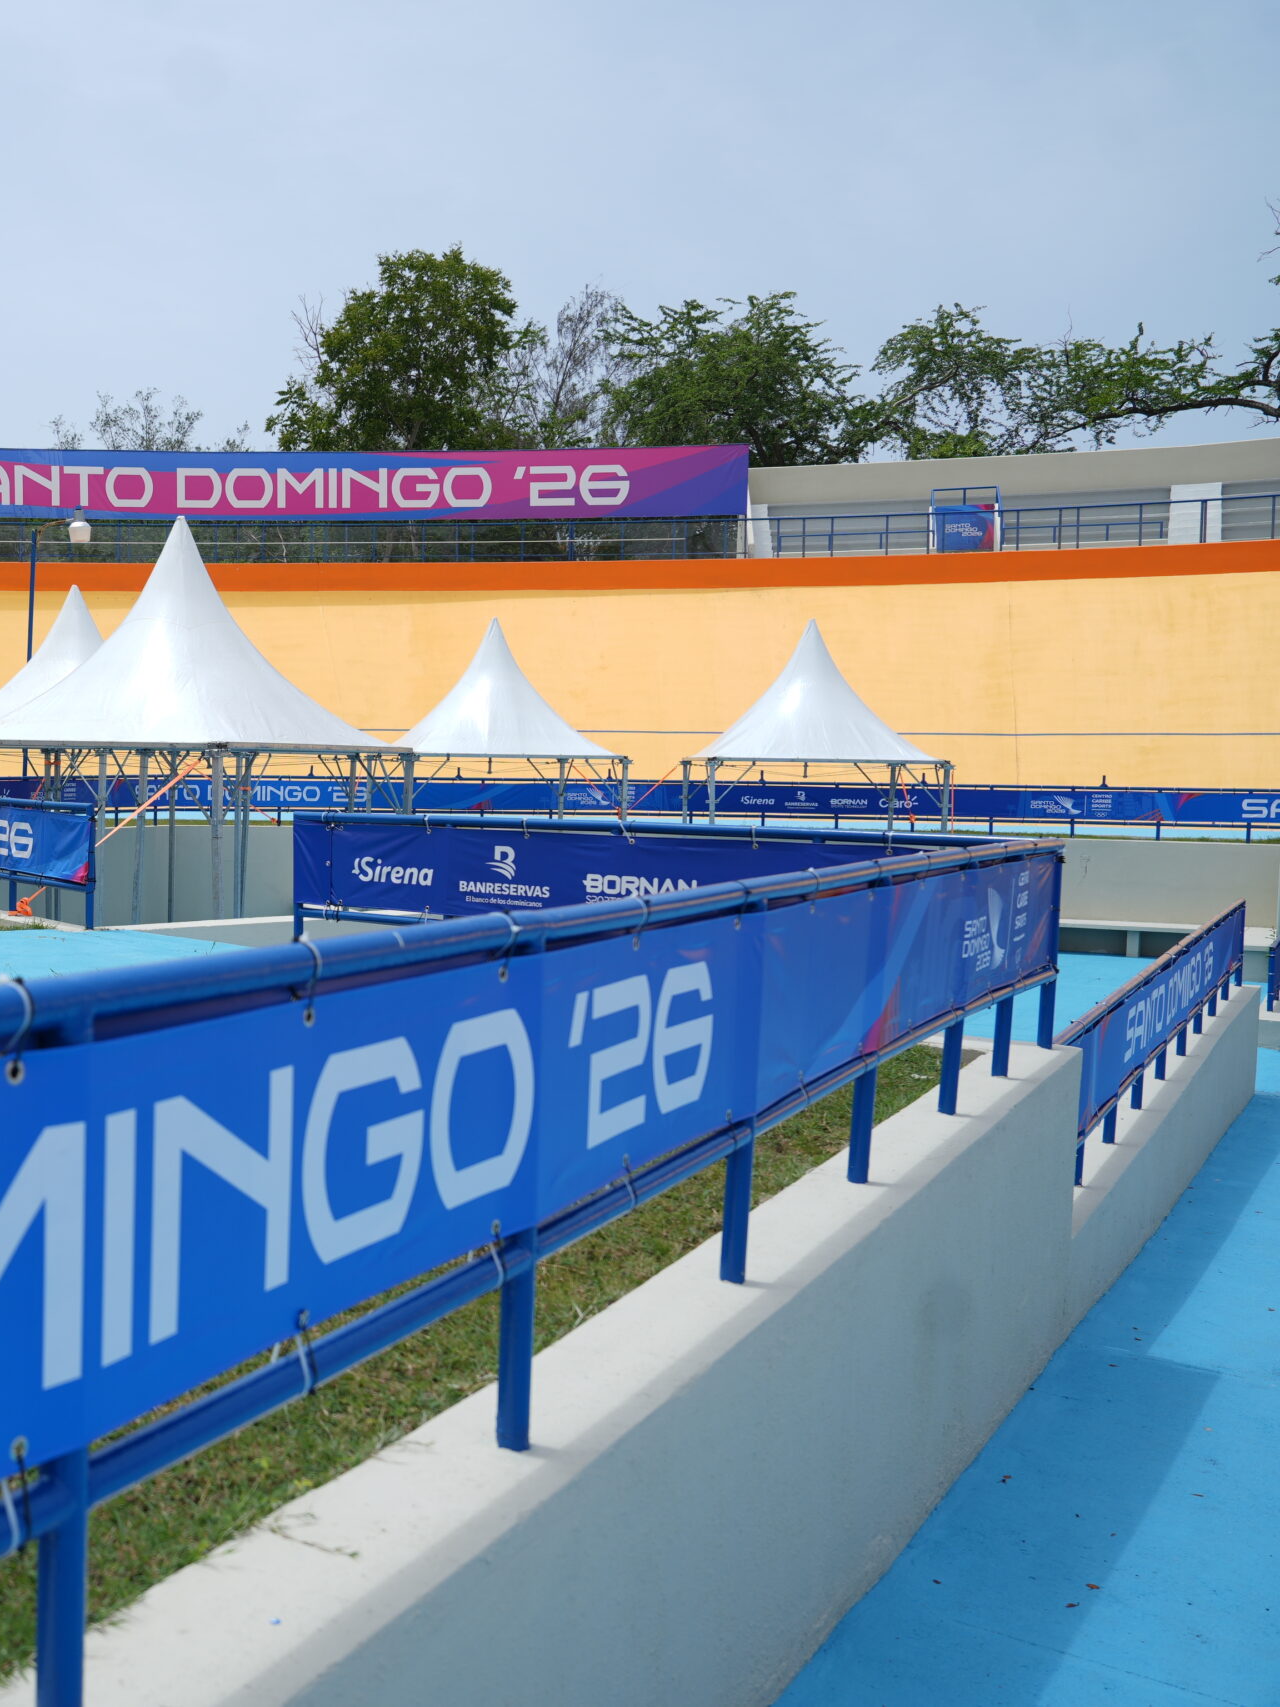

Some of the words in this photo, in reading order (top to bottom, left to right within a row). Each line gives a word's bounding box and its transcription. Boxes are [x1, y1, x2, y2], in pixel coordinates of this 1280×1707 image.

[176, 466, 492, 509] DOMINGO
[513, 464, 630, 507] '26
[741, 795, 775, 805] Sirena
[878, 798, 913, 809] Caro
[358, 856, 434, 886] Sirena
[459, 880, 550, 898] BANRESERVAS
[506, 899, 543, 908] dominicanos
[1124, 983, 1166, 1063] SANTO
[569, 961, 713, 1150] '26
